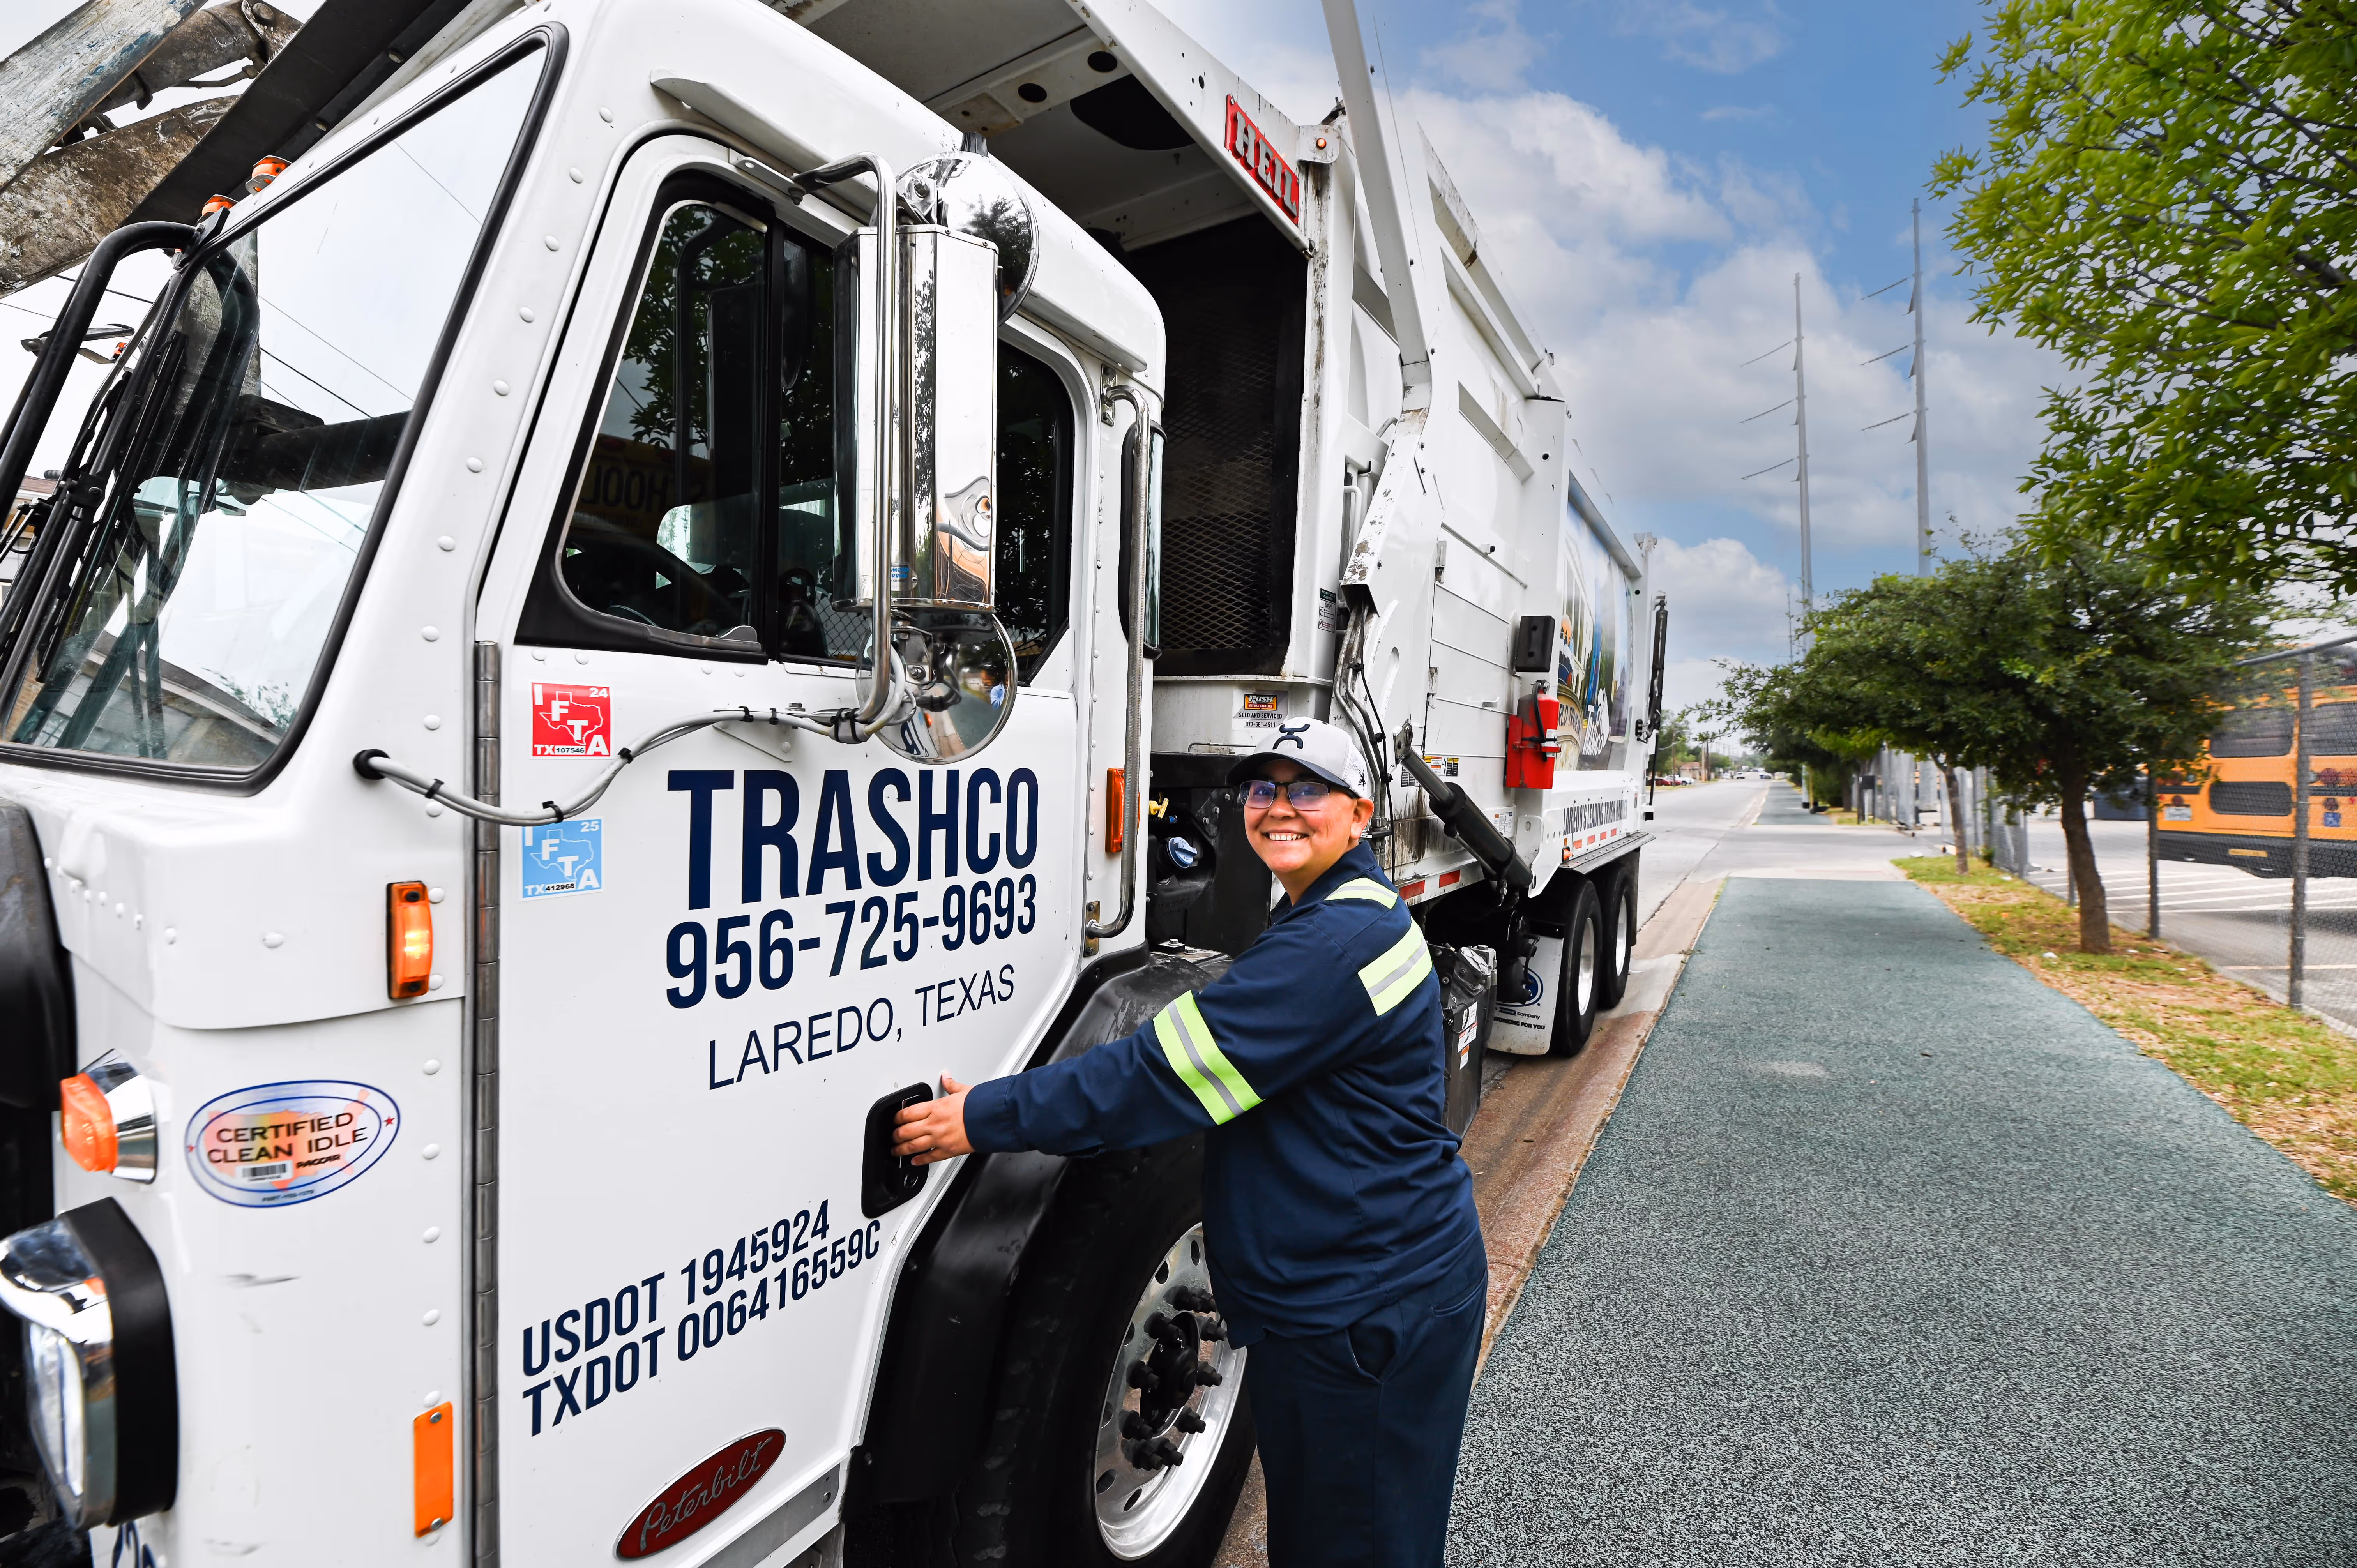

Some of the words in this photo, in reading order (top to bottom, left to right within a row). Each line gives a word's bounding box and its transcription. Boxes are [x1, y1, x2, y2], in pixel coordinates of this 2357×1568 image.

[1235, 111, 1297, 217] HEIL
[589, 687, 608, 699] 24
[1248, 695, 1273, 703] RUSH
[534, 745, 555, 755] TX
[581, 821, 600, 832] 25
[1563, 804, 1587, 835] LAREDO'S
[1587, 802, 1603, 829] LEADING
[668, 768, 1038, 910] TRASHCO
[525, 885, 546, 895] TX
[546, 883, 575, 892] 412968
[666, 874, 1036, 1008] 956-725-9693
[709, 997, 902, 1090] LAREDO,
[915, 964, 1014, 1027] TEXAS
[1517, 1012, 1541, 1020] company
[217, 1112, 353, 1143] CERTIFIED
[207, 1143, 293, 1164] CLEAN
[307, 1127, 368, 1154] IDLE
[523, 1271, 665, 1377] USDOT
[681, 1199, 829, 1306] 1945924
[523, 1328, 665, 1437] TXDOT
[678, 1220, 880, 1361] 006416559C
[639, 1436, 774, 1552] Peterbilt
